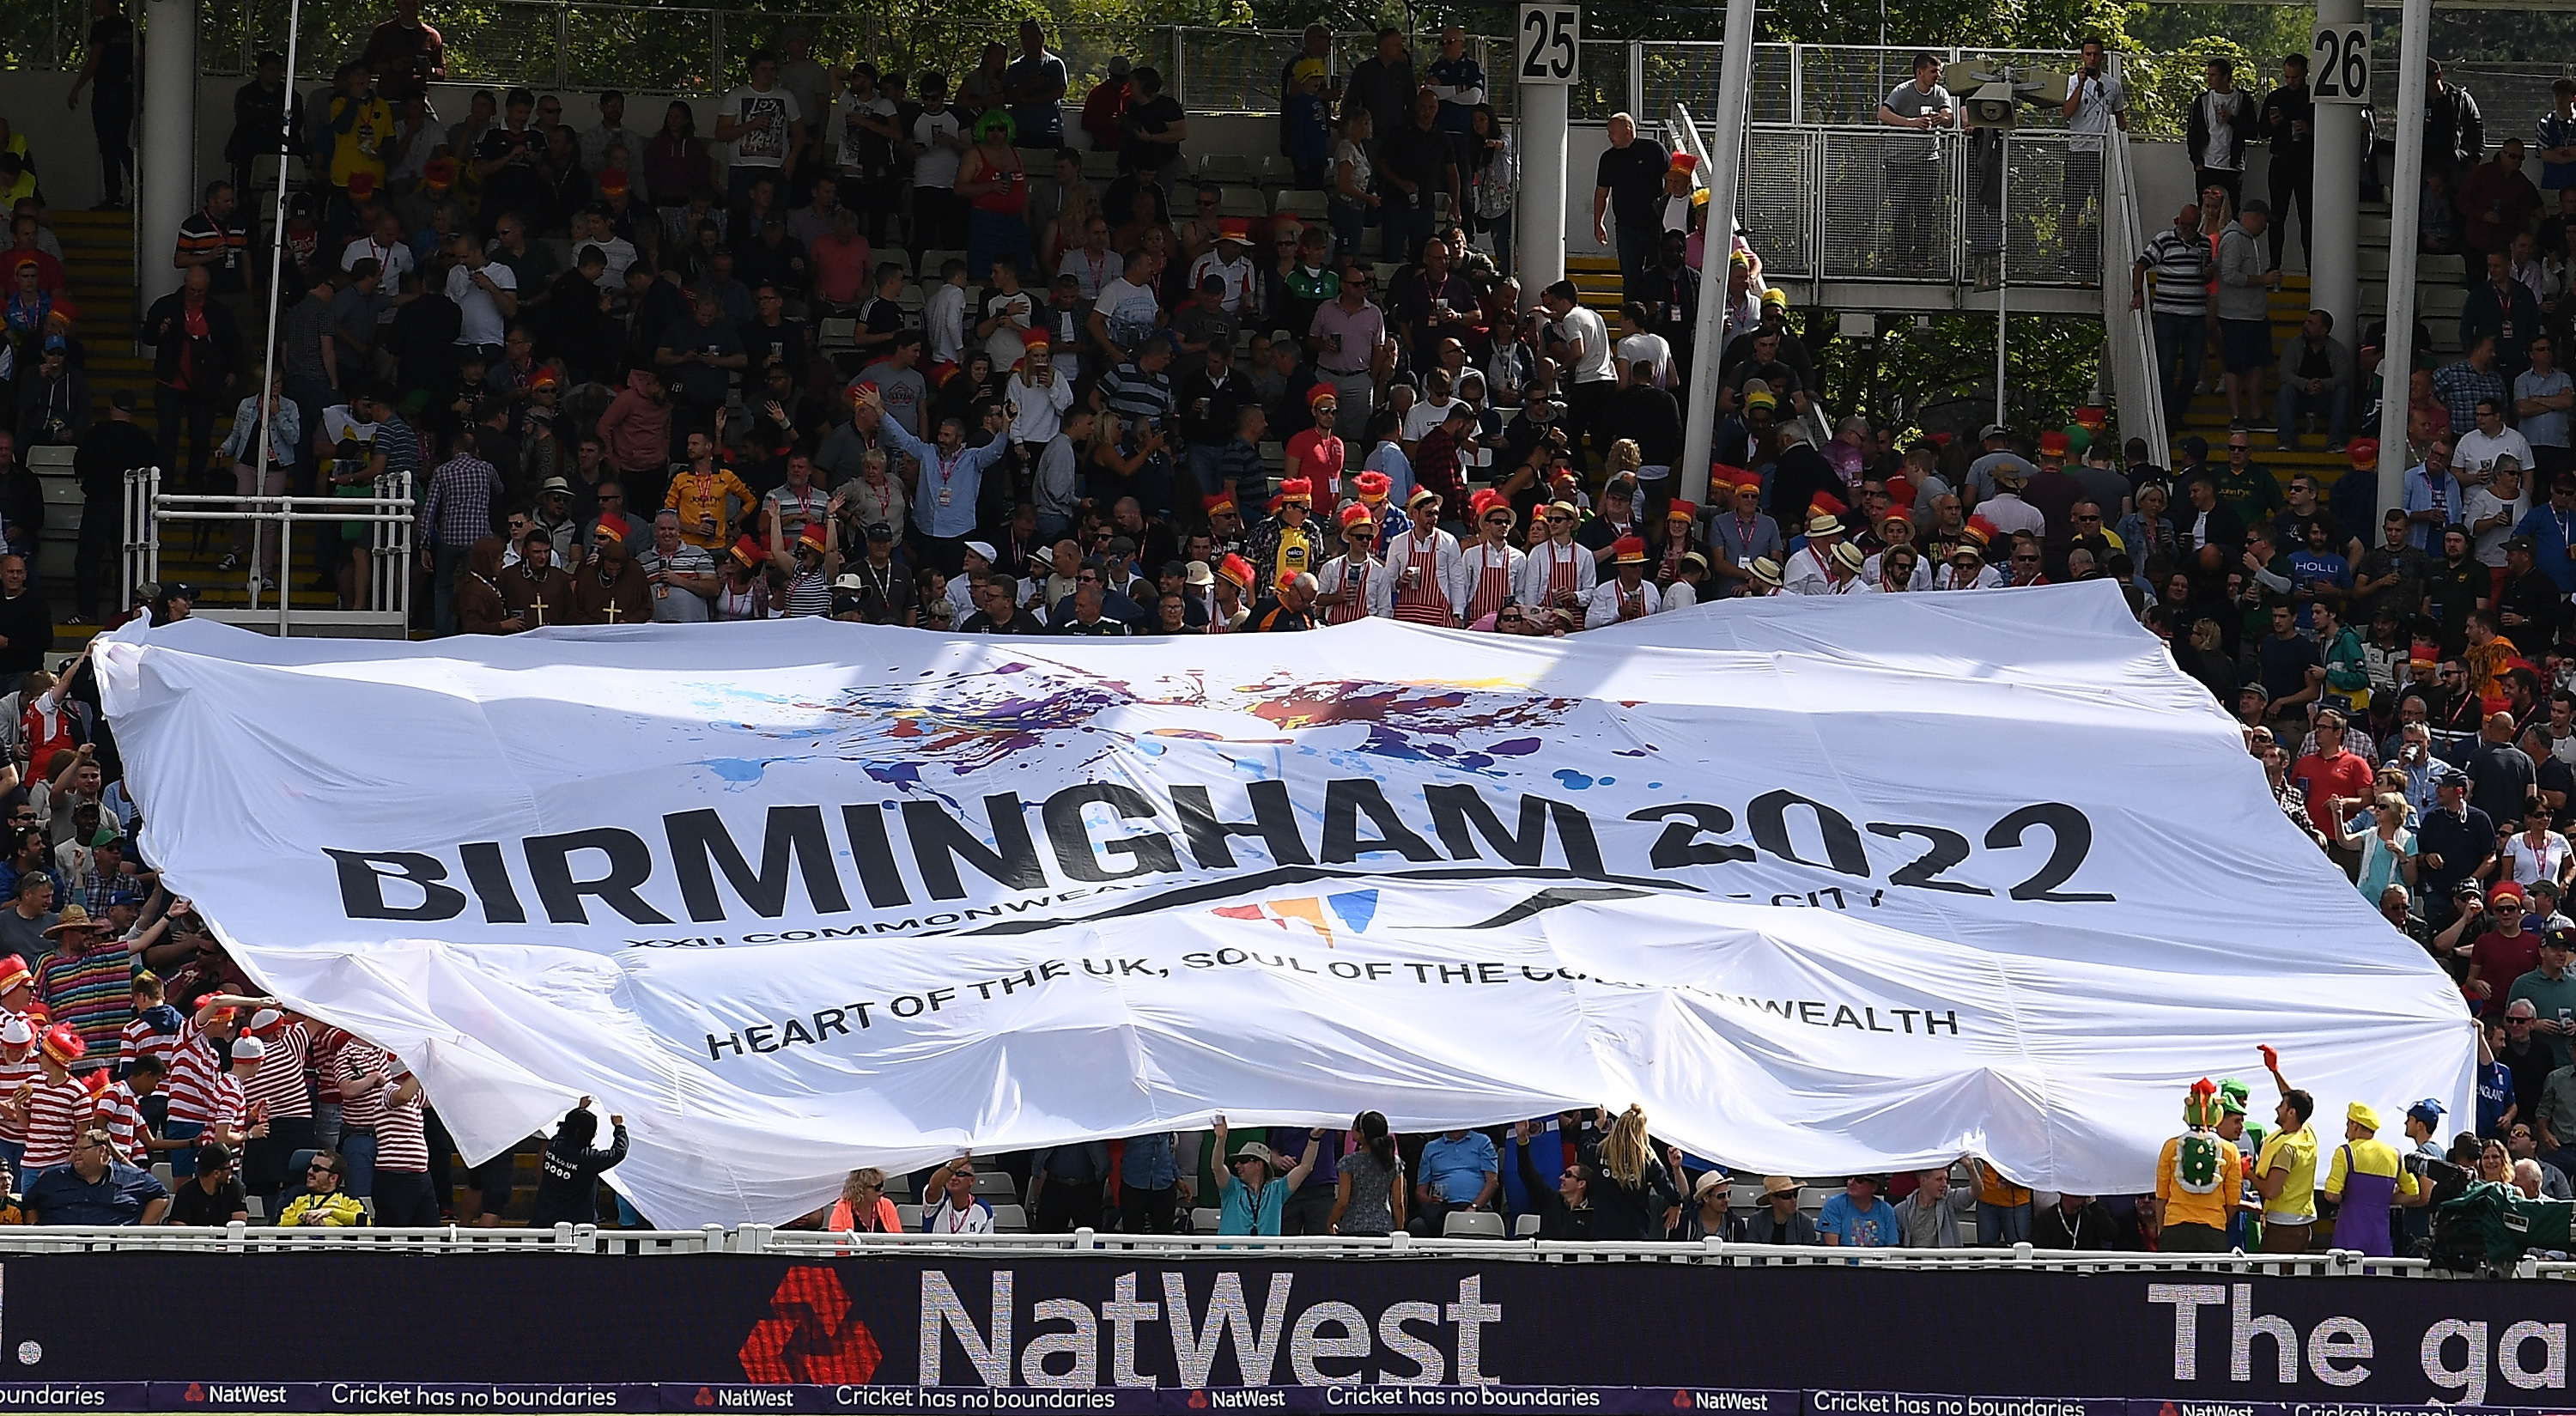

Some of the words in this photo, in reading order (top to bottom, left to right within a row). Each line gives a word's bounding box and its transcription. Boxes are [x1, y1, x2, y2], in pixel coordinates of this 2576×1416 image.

[1522, 10, 1577, 79] 25
[2313, 29, 2366, 98] 26
[323, 779, 1605, 925] BIRMINGHAM
[1625, 788, 2116, 902] 2022
[623, 937, 726, 948] XXII
[742, 885, 1183, 944] COMMONWEA
[706, 1000, 876, 1060] HEART
[890, 987, 957, 1018] OF
[967, 959, 1070, 1001] THE
[1083, 957, 1170, 979] UK,
[1182, 947, 1317, 975] SOUL
[1328, 962, 1392, 981] OF
[1403, 963, 1509, 984] THE
[919, 1271, 1501, 1387] NatWest
[2148, 1283, 2373, 1386] The
[2421, 1318, 2567, 1407] ga
[209, 1385, 287, 1403] NatWest
[331, 1383, 411, 1405] Cricket
[416, 1385, 454, 1406] has
[461, 1390, 488, 1407] no
[493, 1386, 617, 1407] boundaries
[719, 1389, 794, 1407] NatWest
[835, 1385, 914, 1407] Cricket
[919, 1387, 957, 1408] has
[962, 1392, 990, 1408] no
[993, 1389, 1115, 1408] boundaries
[1212, 1389, 1286, 1408] NatWest
[1327, 1386, 1404, 1407] Cricket
[1408, 1386, 1446, 1407] has
[1450, 1391, 1478, 1407] no
[1481, 1387, 1601, 1407] boundaries
[1696, 1392, 1768, 1412] NatWest
[1814, 1390, 1890, 1413] Cricket
[1895, 1392, 1930, 1414] has
[1937, 1400, 1963, 1415] no
[1968, 1396, 2085, 1416] boundaries
